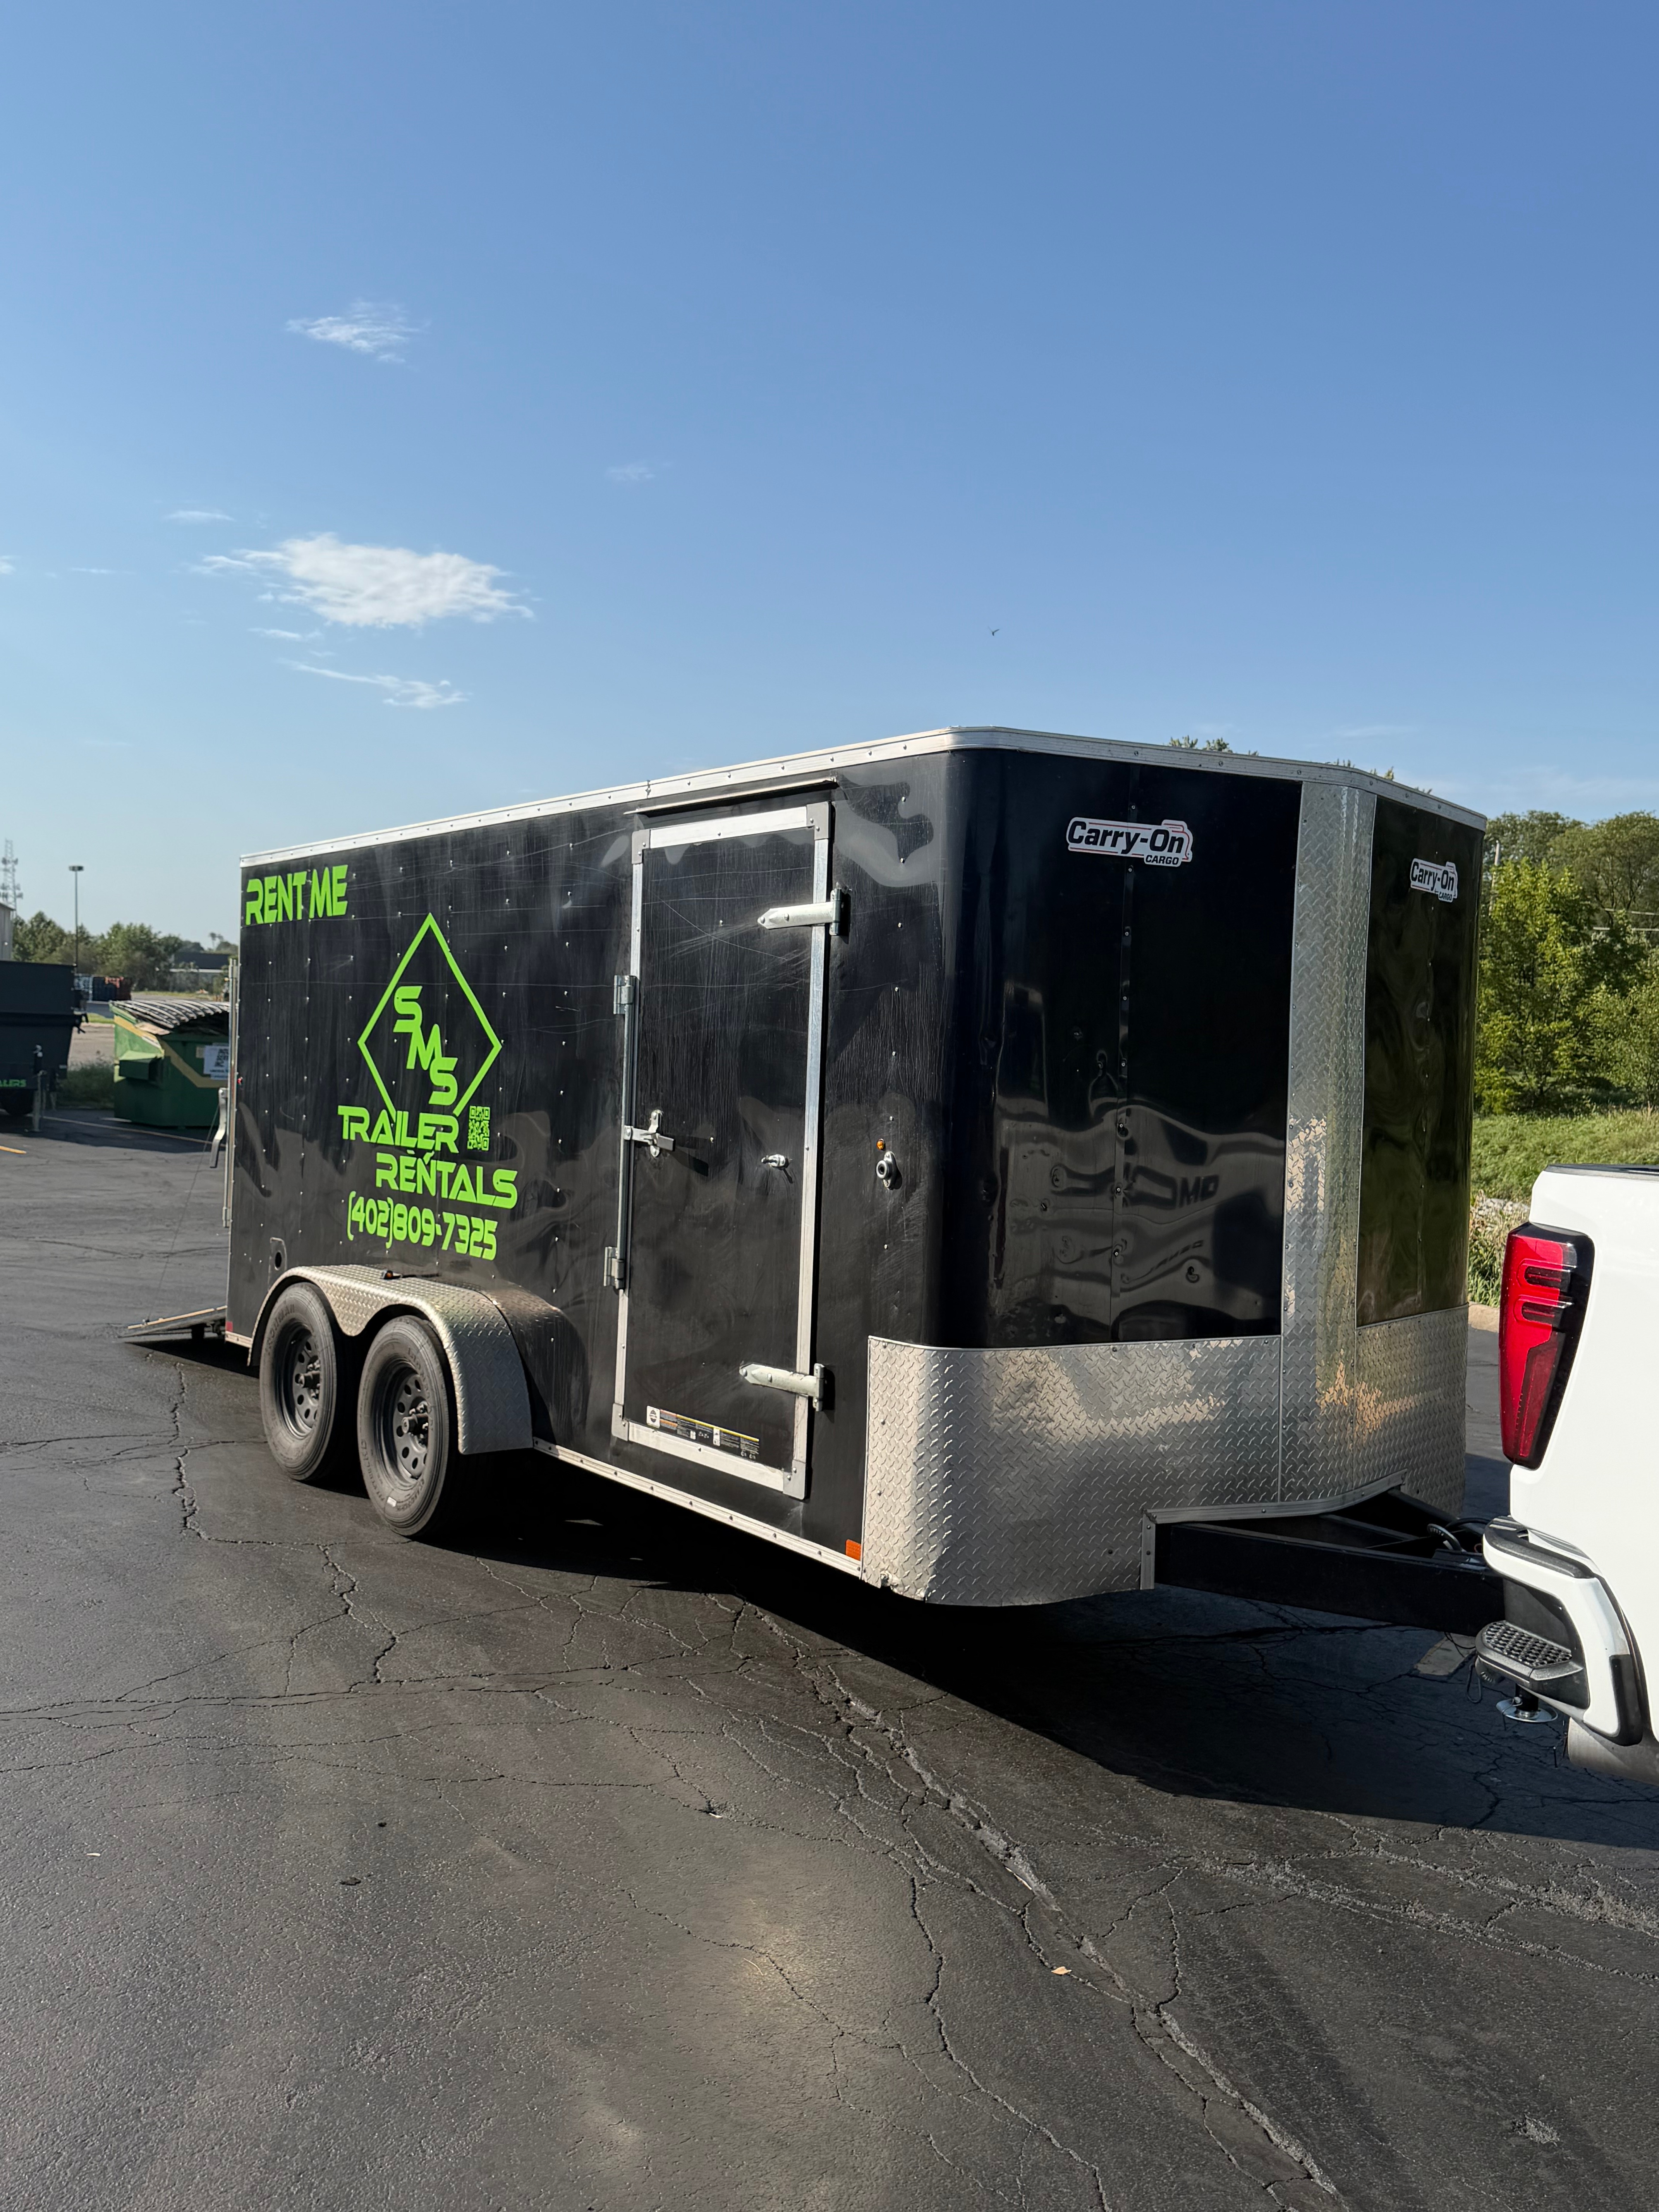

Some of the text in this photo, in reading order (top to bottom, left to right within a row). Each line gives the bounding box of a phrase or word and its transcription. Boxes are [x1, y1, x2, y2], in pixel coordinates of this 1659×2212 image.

[1068, 821, 1184, 854] Carry-On
[1145, 854, 1179, 865] CARGO
[1411, 861, 1455, 891] Carry-On
[246, 864, 348, 926] RENT ME
[1439, 891, 1453, 901] CARGO
[337, 1105, 459, 1154] TRAILER
[376, 1152, 518, 1209] RENTALS
[347, 1190, 498, 1261] (402)809-7325
